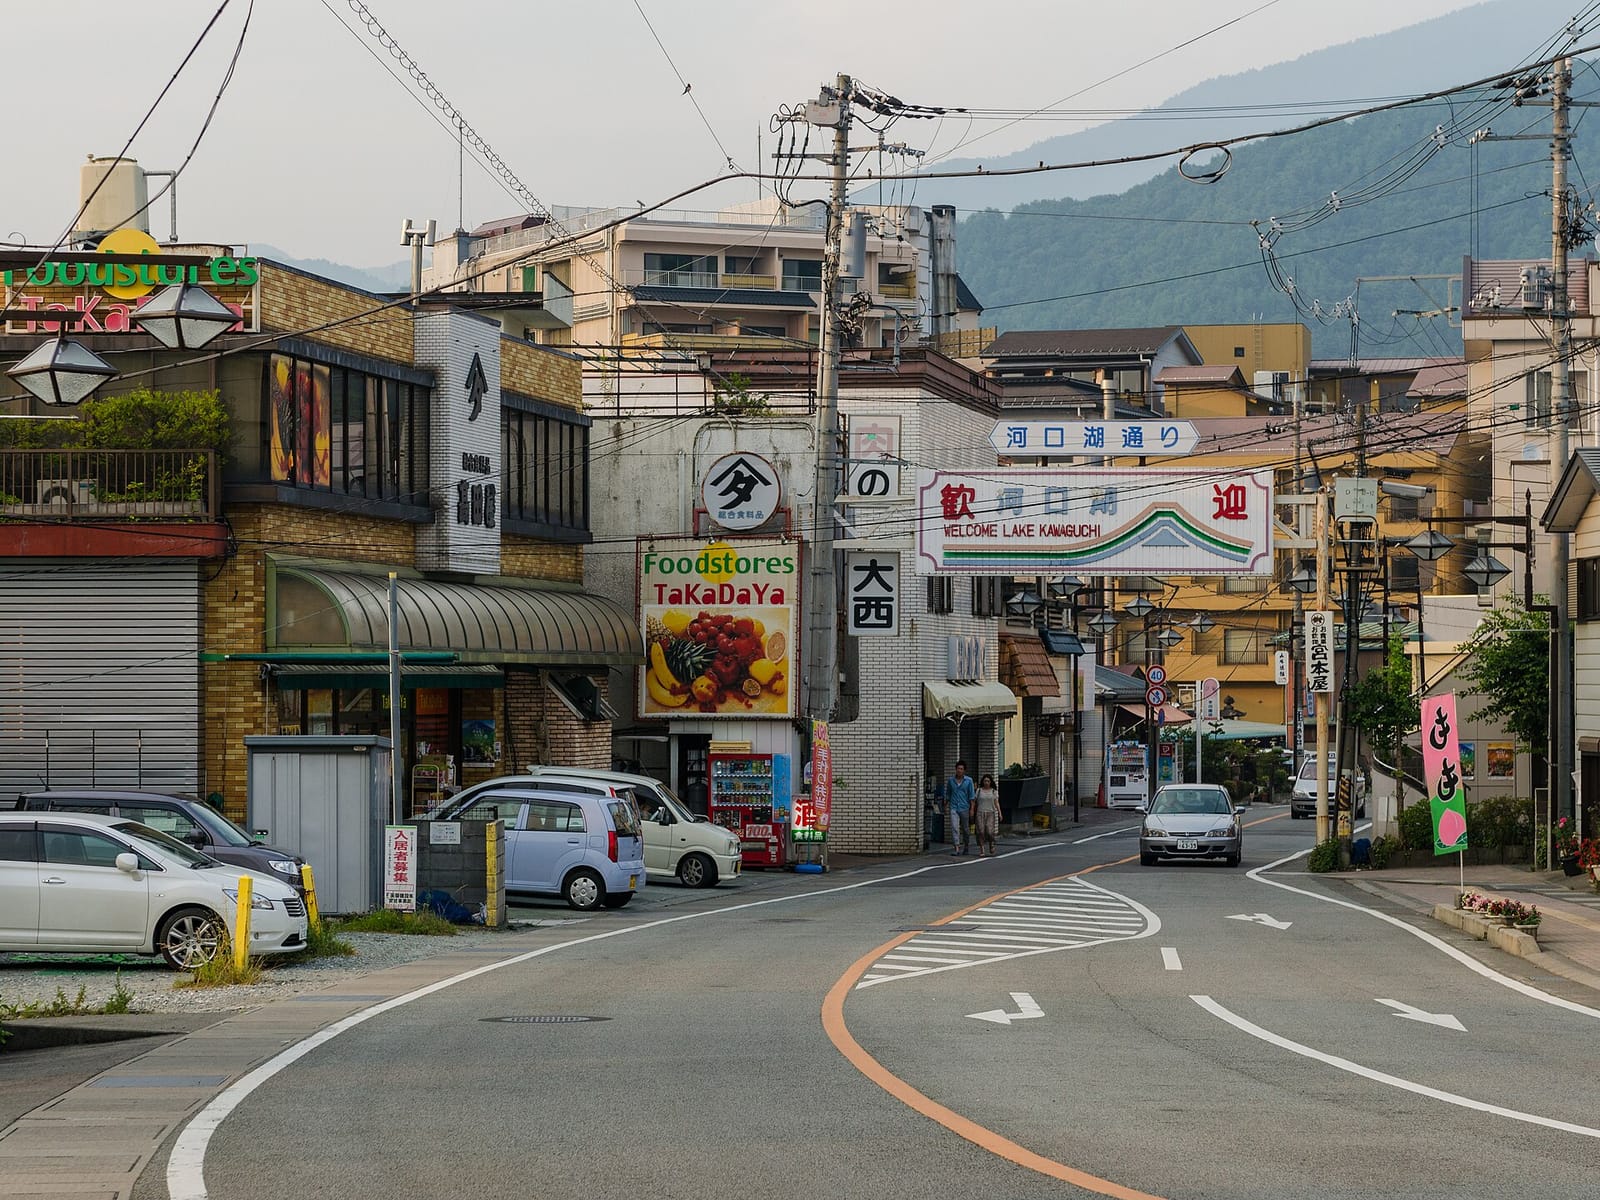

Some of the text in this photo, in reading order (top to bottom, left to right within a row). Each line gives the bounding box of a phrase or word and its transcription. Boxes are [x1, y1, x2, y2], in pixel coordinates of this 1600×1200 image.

[1007, 426, 1179, 449] 河口湖通り
[944, 524, 1101, 538] WELCOME LAKE KAWAGUCHI
[643, 553, 794, 575] Foodstores
[654, 582, 785, 606] TaKaDaYa
[853, 559, 894, 628] 大西
[1150, 670, 1162, 680] 40
[1310, 644, 1330, 691] 宮本屋
[393, 830, 409, 883] 入居者募集
